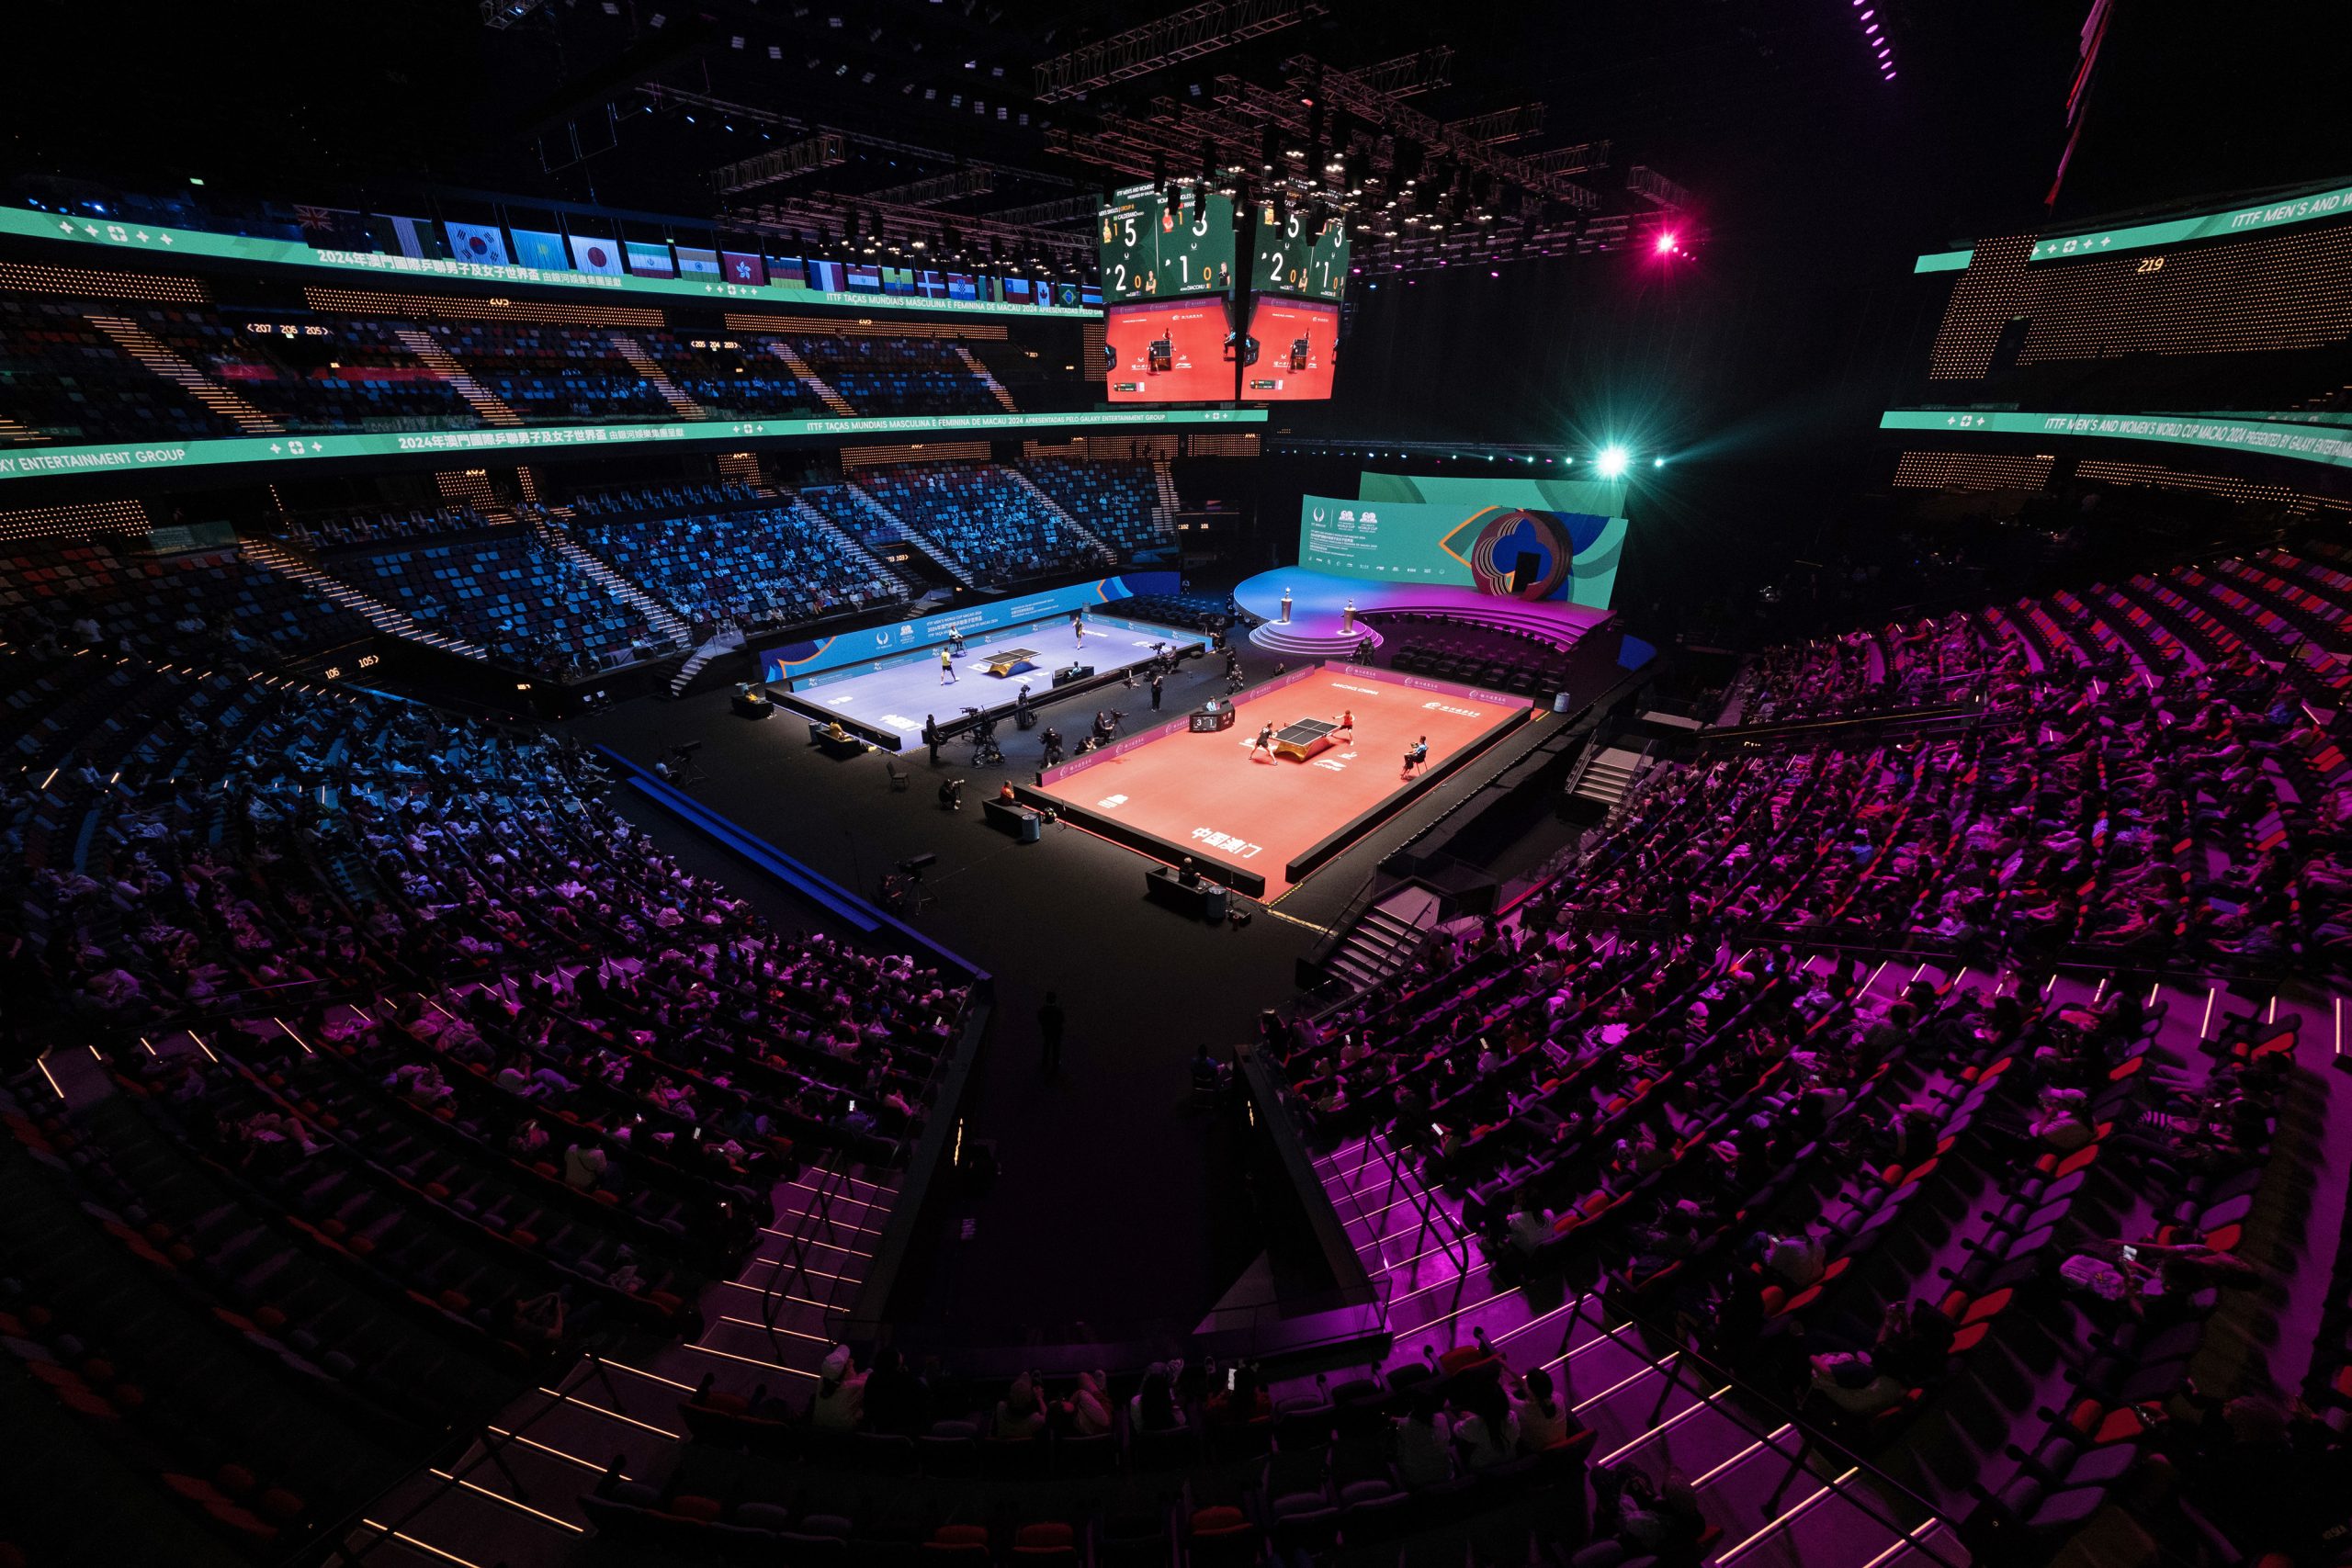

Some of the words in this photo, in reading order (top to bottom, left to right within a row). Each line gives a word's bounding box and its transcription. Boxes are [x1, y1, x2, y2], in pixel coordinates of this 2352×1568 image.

[2231, 210, 2264, 229] ITTF
[2262, 201, 2309, 223] MEN'S
[2308, 195, 2341, 214] AND
[1125, 219, 1137, 247] 5
[1180, 255, 1189, 284] 1
[1203, 266, 1213, 281] 0
[1271, 253, 1284, 282] 2
[1289, 269, 1297, 284] 0
[1323, 261, 1330, 288] 1
[2137, 258, 2165, 273] 219
[1114, 264, 1127, 291] 2
[1134, 275, 1142, 288] 0
[827, 293, 842, 302] ITTF
[844, 294, 867, 305] TAÇAS
[869, 297, 904, 307] MUNDIAIS
[906, 299, 946, 310] MASCULINA
[954, 301, 986, 311] FEMININA
[987, 303, 996, 311] DE
[997, 304, 1022, 313] MACAU
[1023, 305, 1038, 314] 2024
[254, 323, 273, 333] 207
[279, 324, 300, 334] 206
[304, 326, 323, 335] 205
[808, 422, 824, 432] ITTF
[826, 421, 850, 433] TAÇAS
[851, 420, 888, 430] MUNDIAIS
[889, 418, 931, 428] MASCULINA
[932, 419, 936, 427] E
[937, 417, 971, 427] FEMININA
[972, 417, 981, 425] DE
[982, 416, 1007, 425] MACAU
[1008, 416, 1023, 424] 2024
[1024, 416, 1065, 424] APRESENTADAS
[1102, 414, 1145, 423] ENTERTAINMENT
[2044, 418, 2067, 430] ITTF
[2066, 419, 2099, 432] MEN'S
[2098, 420, 2119, 432] AND
[2120, 421, 2157, 435] WOMEN'S
[2155, 423, 2184, 437] WORLD
[2181, 424, 2199, 439] CUP
[2197, 425, 2229, 441] MACAO
[2225, 427, 2247, 444] 2024
[2245, 431, 2283, 448] PRESENTED
[2278, 434, 2292, 448] BY
[2289, 435, 2318, 452] GALAXY
[18, 452, 131, 471] ENTERTAINMENT
[135, 449, 186, 463] GROUP
[325, 667, 340, 680] 106
[358, 656, 374, 669] 105
[1196, 718, 1203, 727] 3
[1209, 718, 1214, 727] 1
[1191, 827, 1262, 858] 中国澳门
